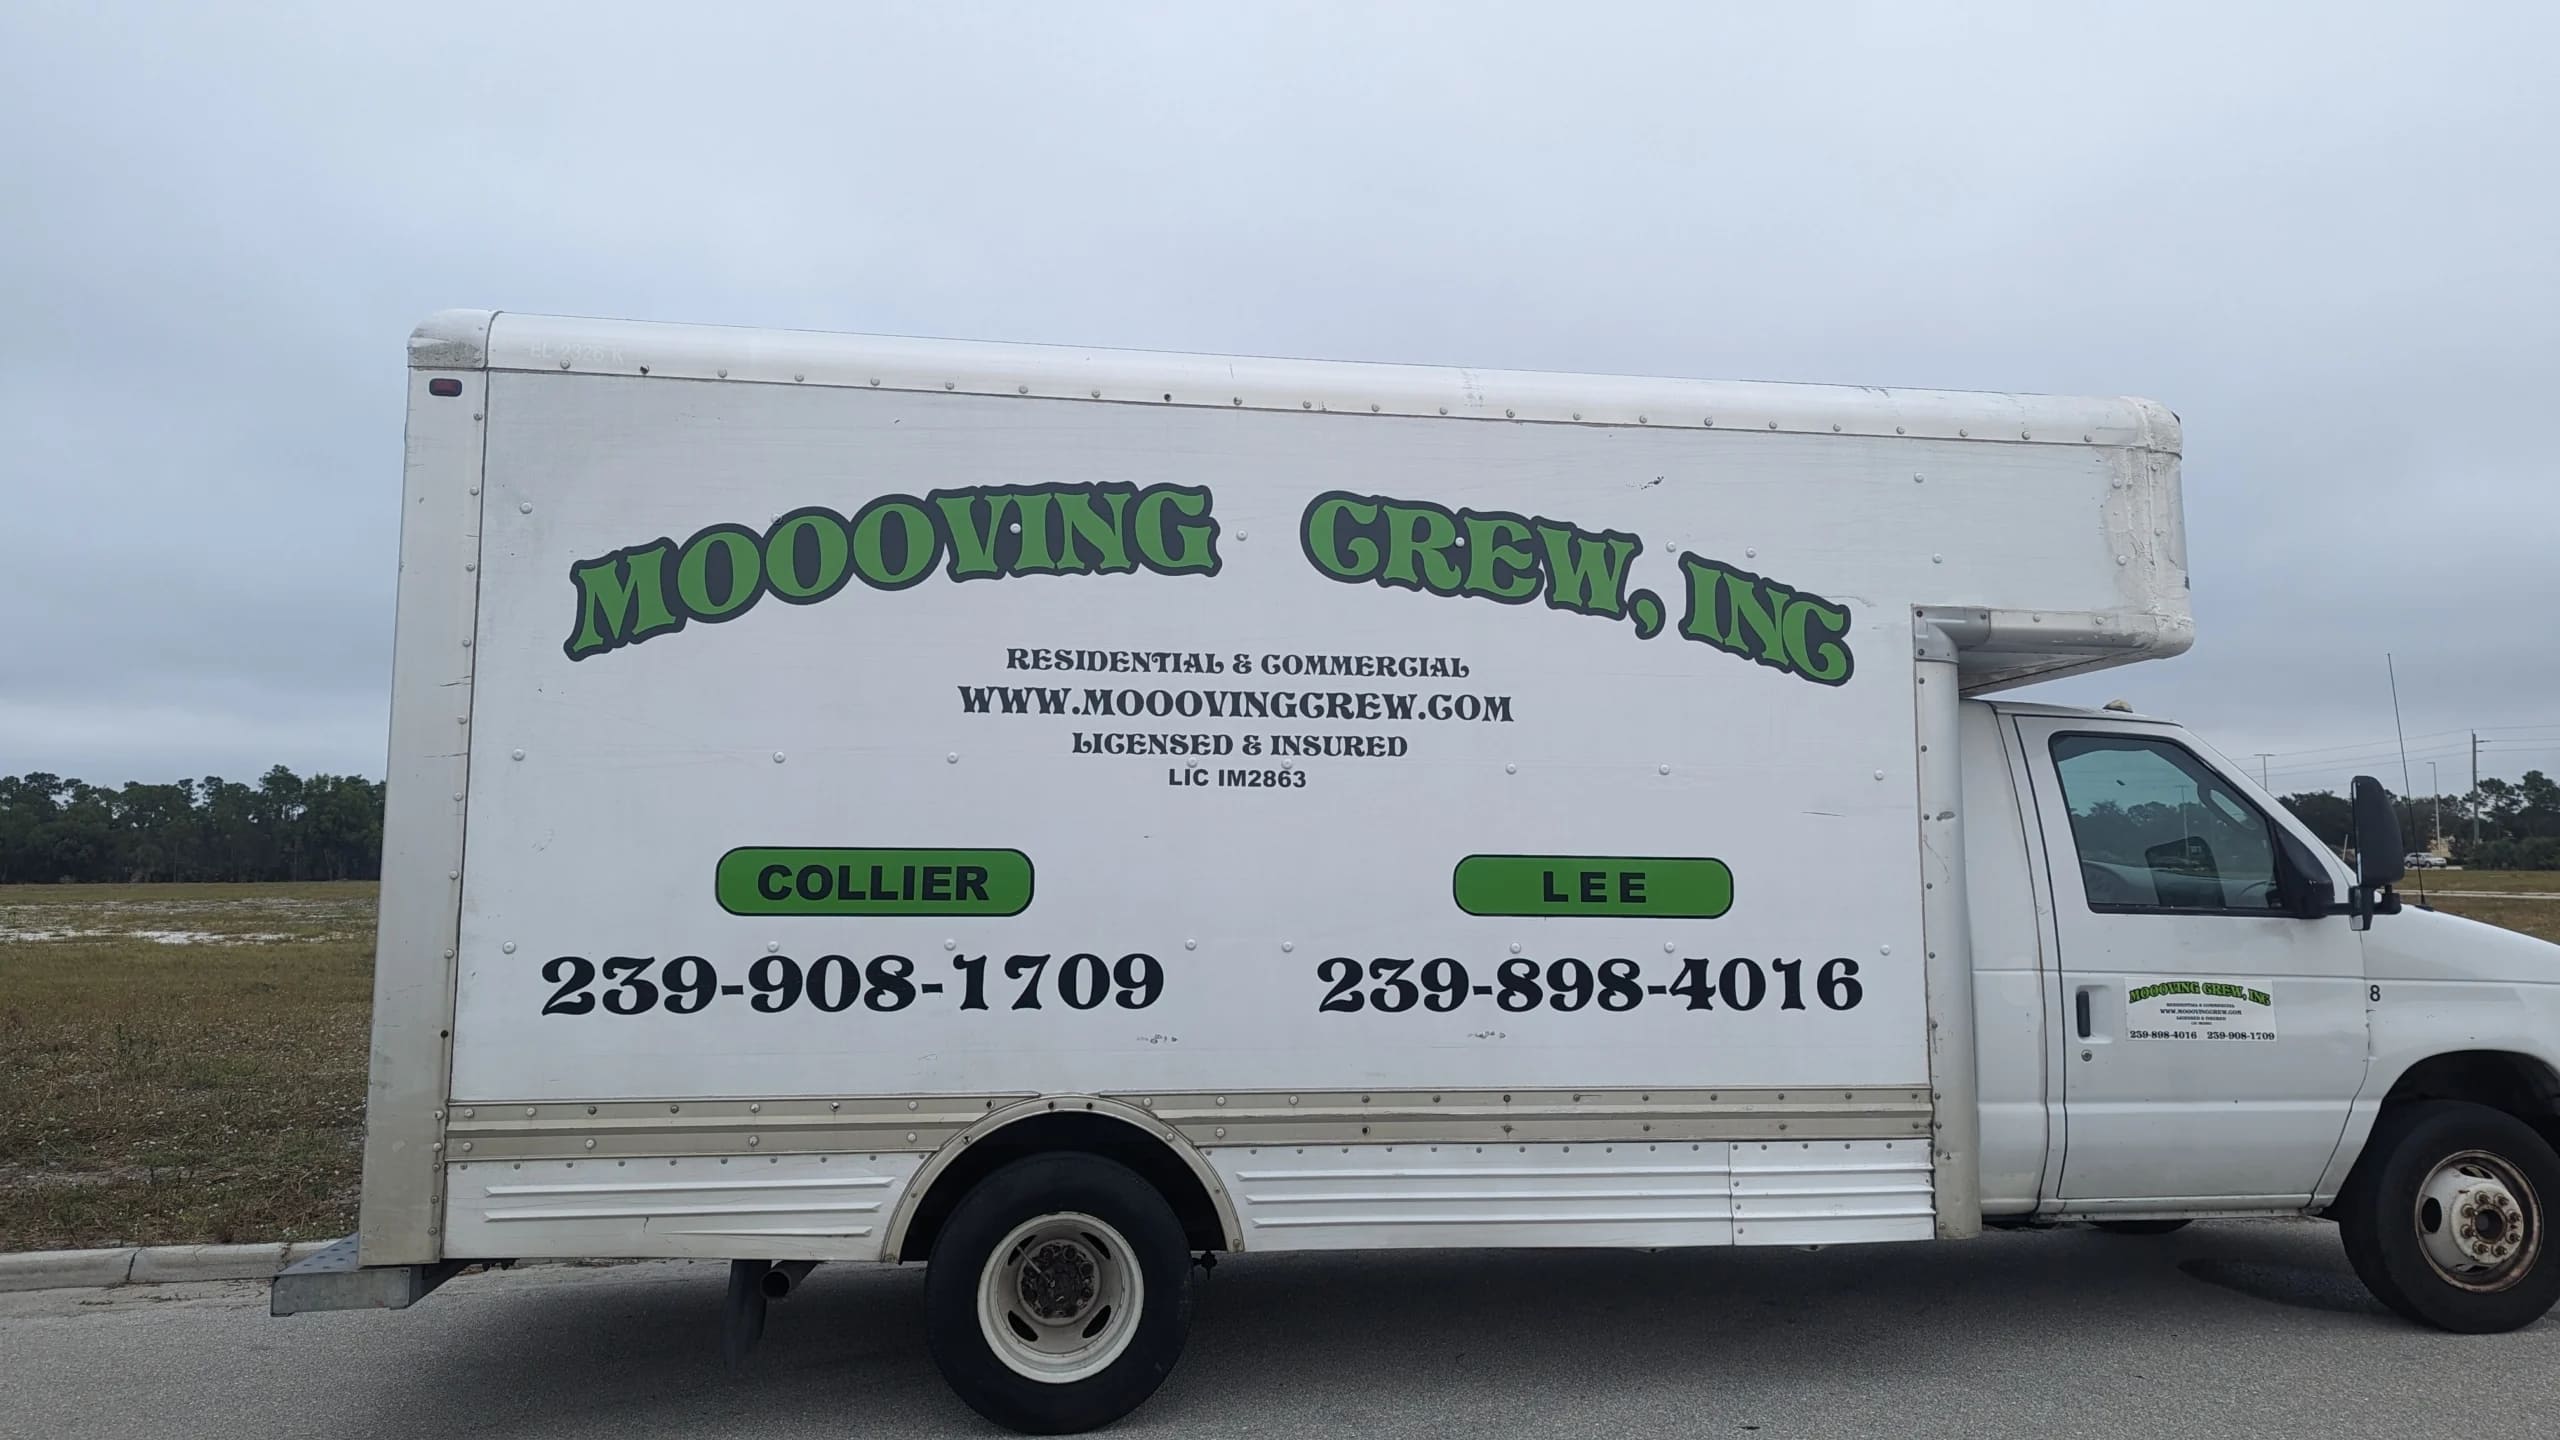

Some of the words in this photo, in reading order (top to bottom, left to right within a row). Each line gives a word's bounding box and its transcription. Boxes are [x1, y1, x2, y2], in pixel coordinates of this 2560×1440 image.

[565, 481, 1224, 661] MOOOVING
[1300, 489, 1666, 640] CREW,
[1678, 551, 1854, 687] INC
[1006, 647, 1225, 674] RESIDENTIAL
[1232, 653, 1253, 675] &
[1260, 654, 1470, 678] COMMERCIAL
[957, 685, 1515, 722] WWW.MOOOVINGCREW.COM
[1071, 732, 1234, 756] LICENSED
[1242, 734, 1262, 756] &
[1270, 735, 1408, 757] INSURED
[1168, 768, 1209, 787] LIC
[1218, 769, 1307, 788] IM2863
[757, 864, 990, 901] COLLIER
[1543, 871, 1647, 904] LEE
[541, 953, 1164, 1016] 239-908-1709
[1317, 957, 1863, 1013] 239-898-4016
[2129, 981, 2200, 1003] MOOOVING
[2369, 984, 2381, 1002] 8
[2130, 1030, 2197, 1040] 239-898-4016
[2207, 1031, 2275, 1041] 239-908-1709
